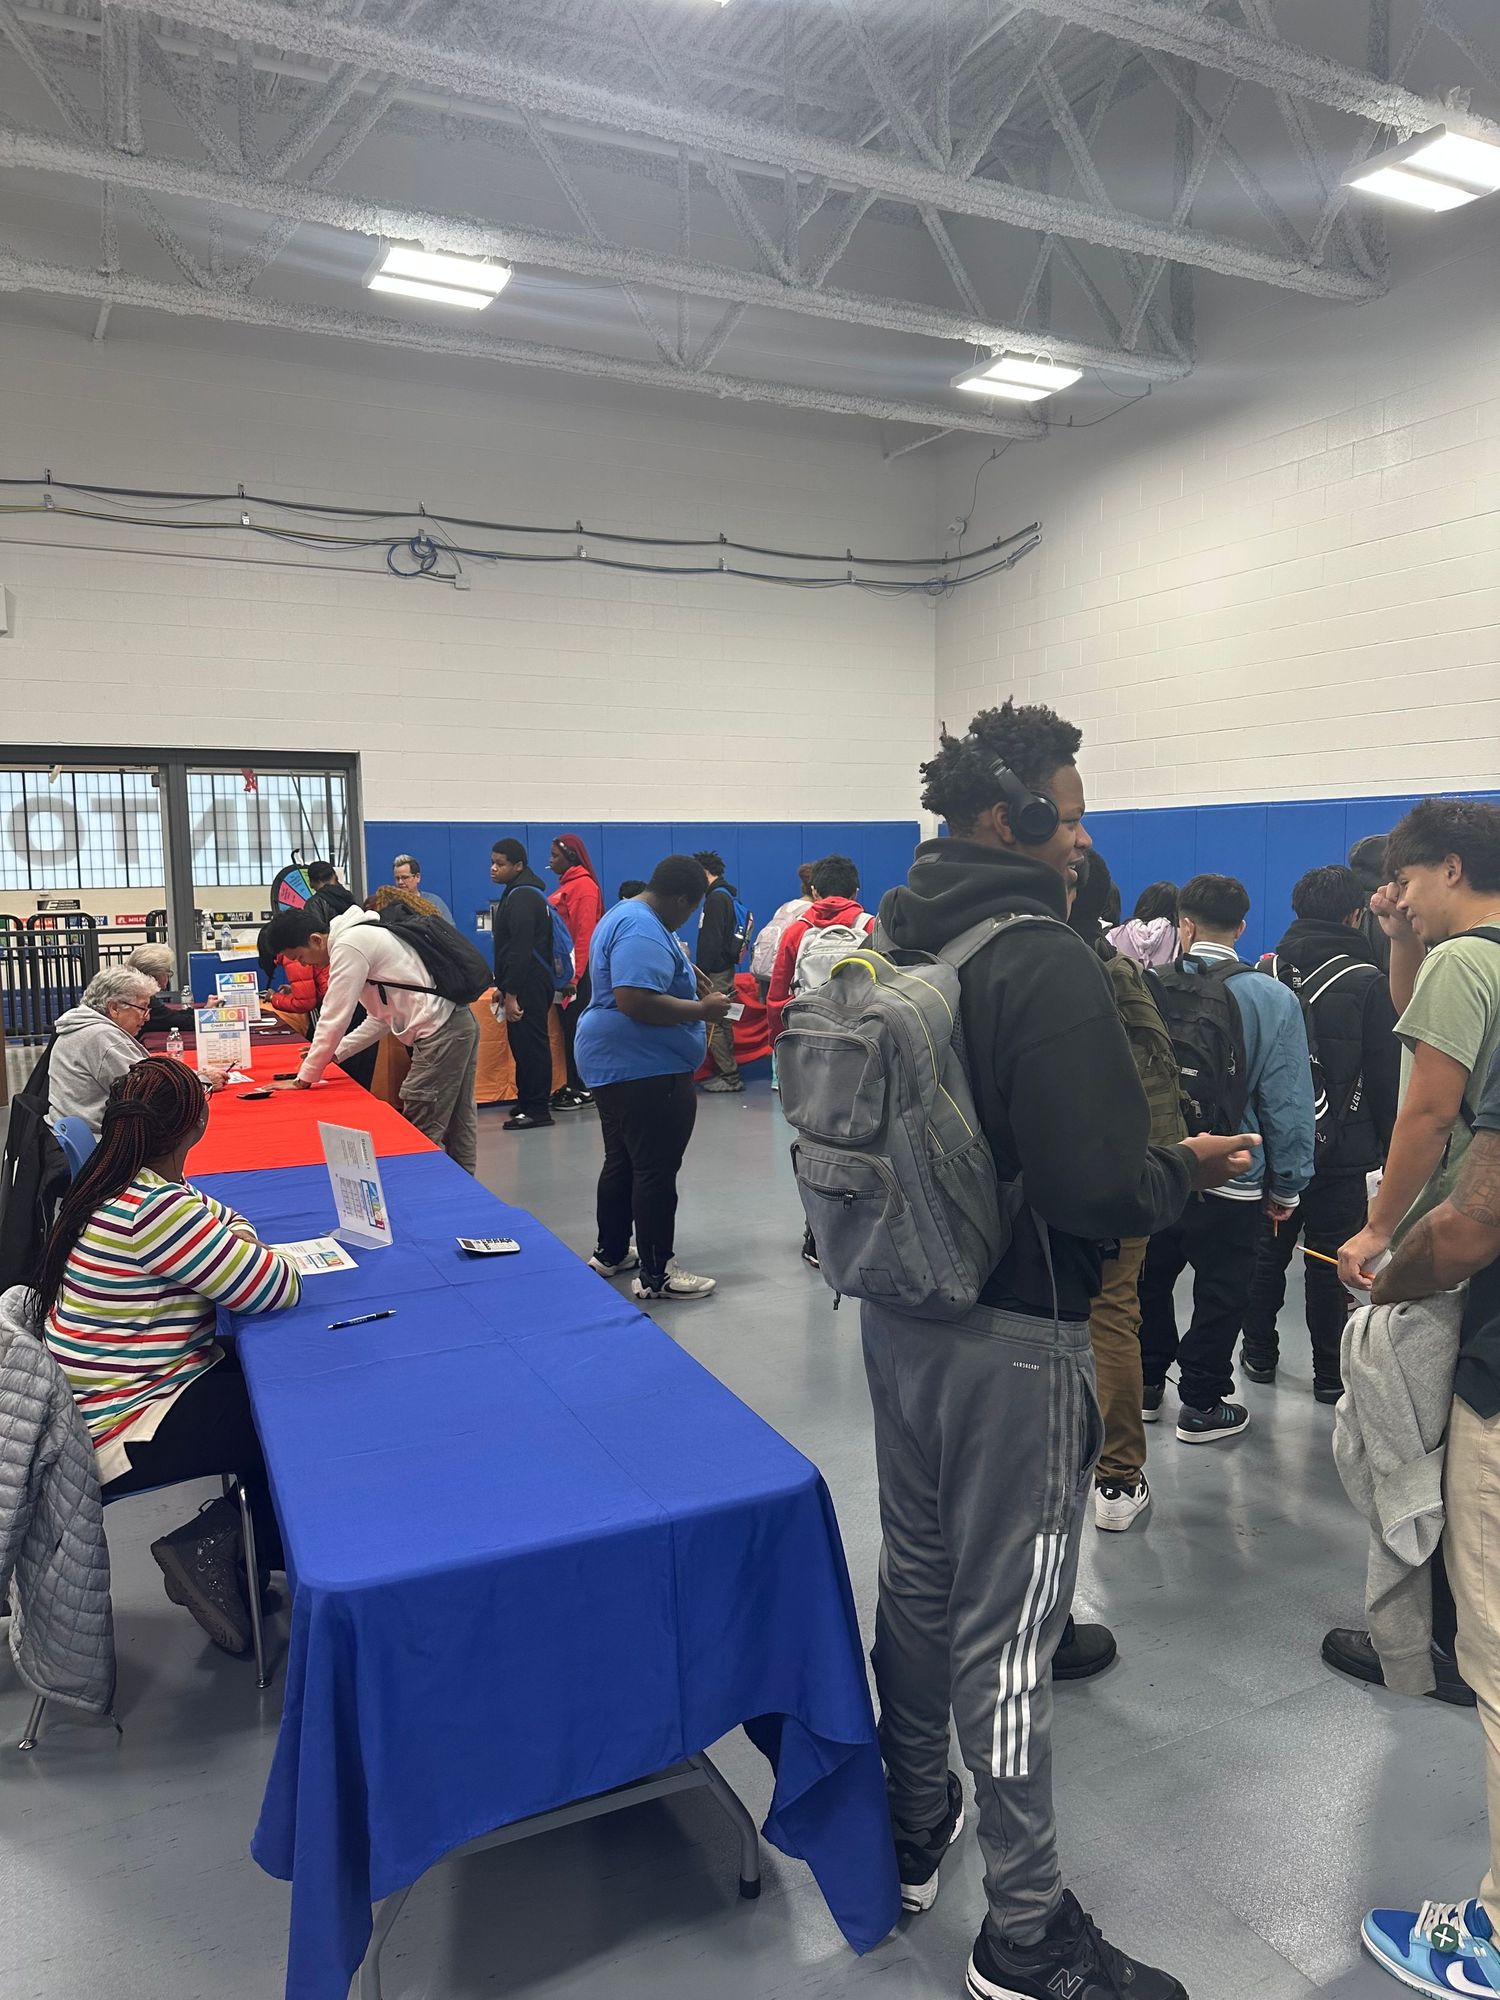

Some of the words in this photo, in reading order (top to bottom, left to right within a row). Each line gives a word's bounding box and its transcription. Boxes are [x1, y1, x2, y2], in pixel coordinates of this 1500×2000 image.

[236, 974, 254, 982] 101
[220, 1010, 244, 1021] 101
[1350, 1091, 1362, 1112] 1975
[1047, 1968, 1084, 2000] N
